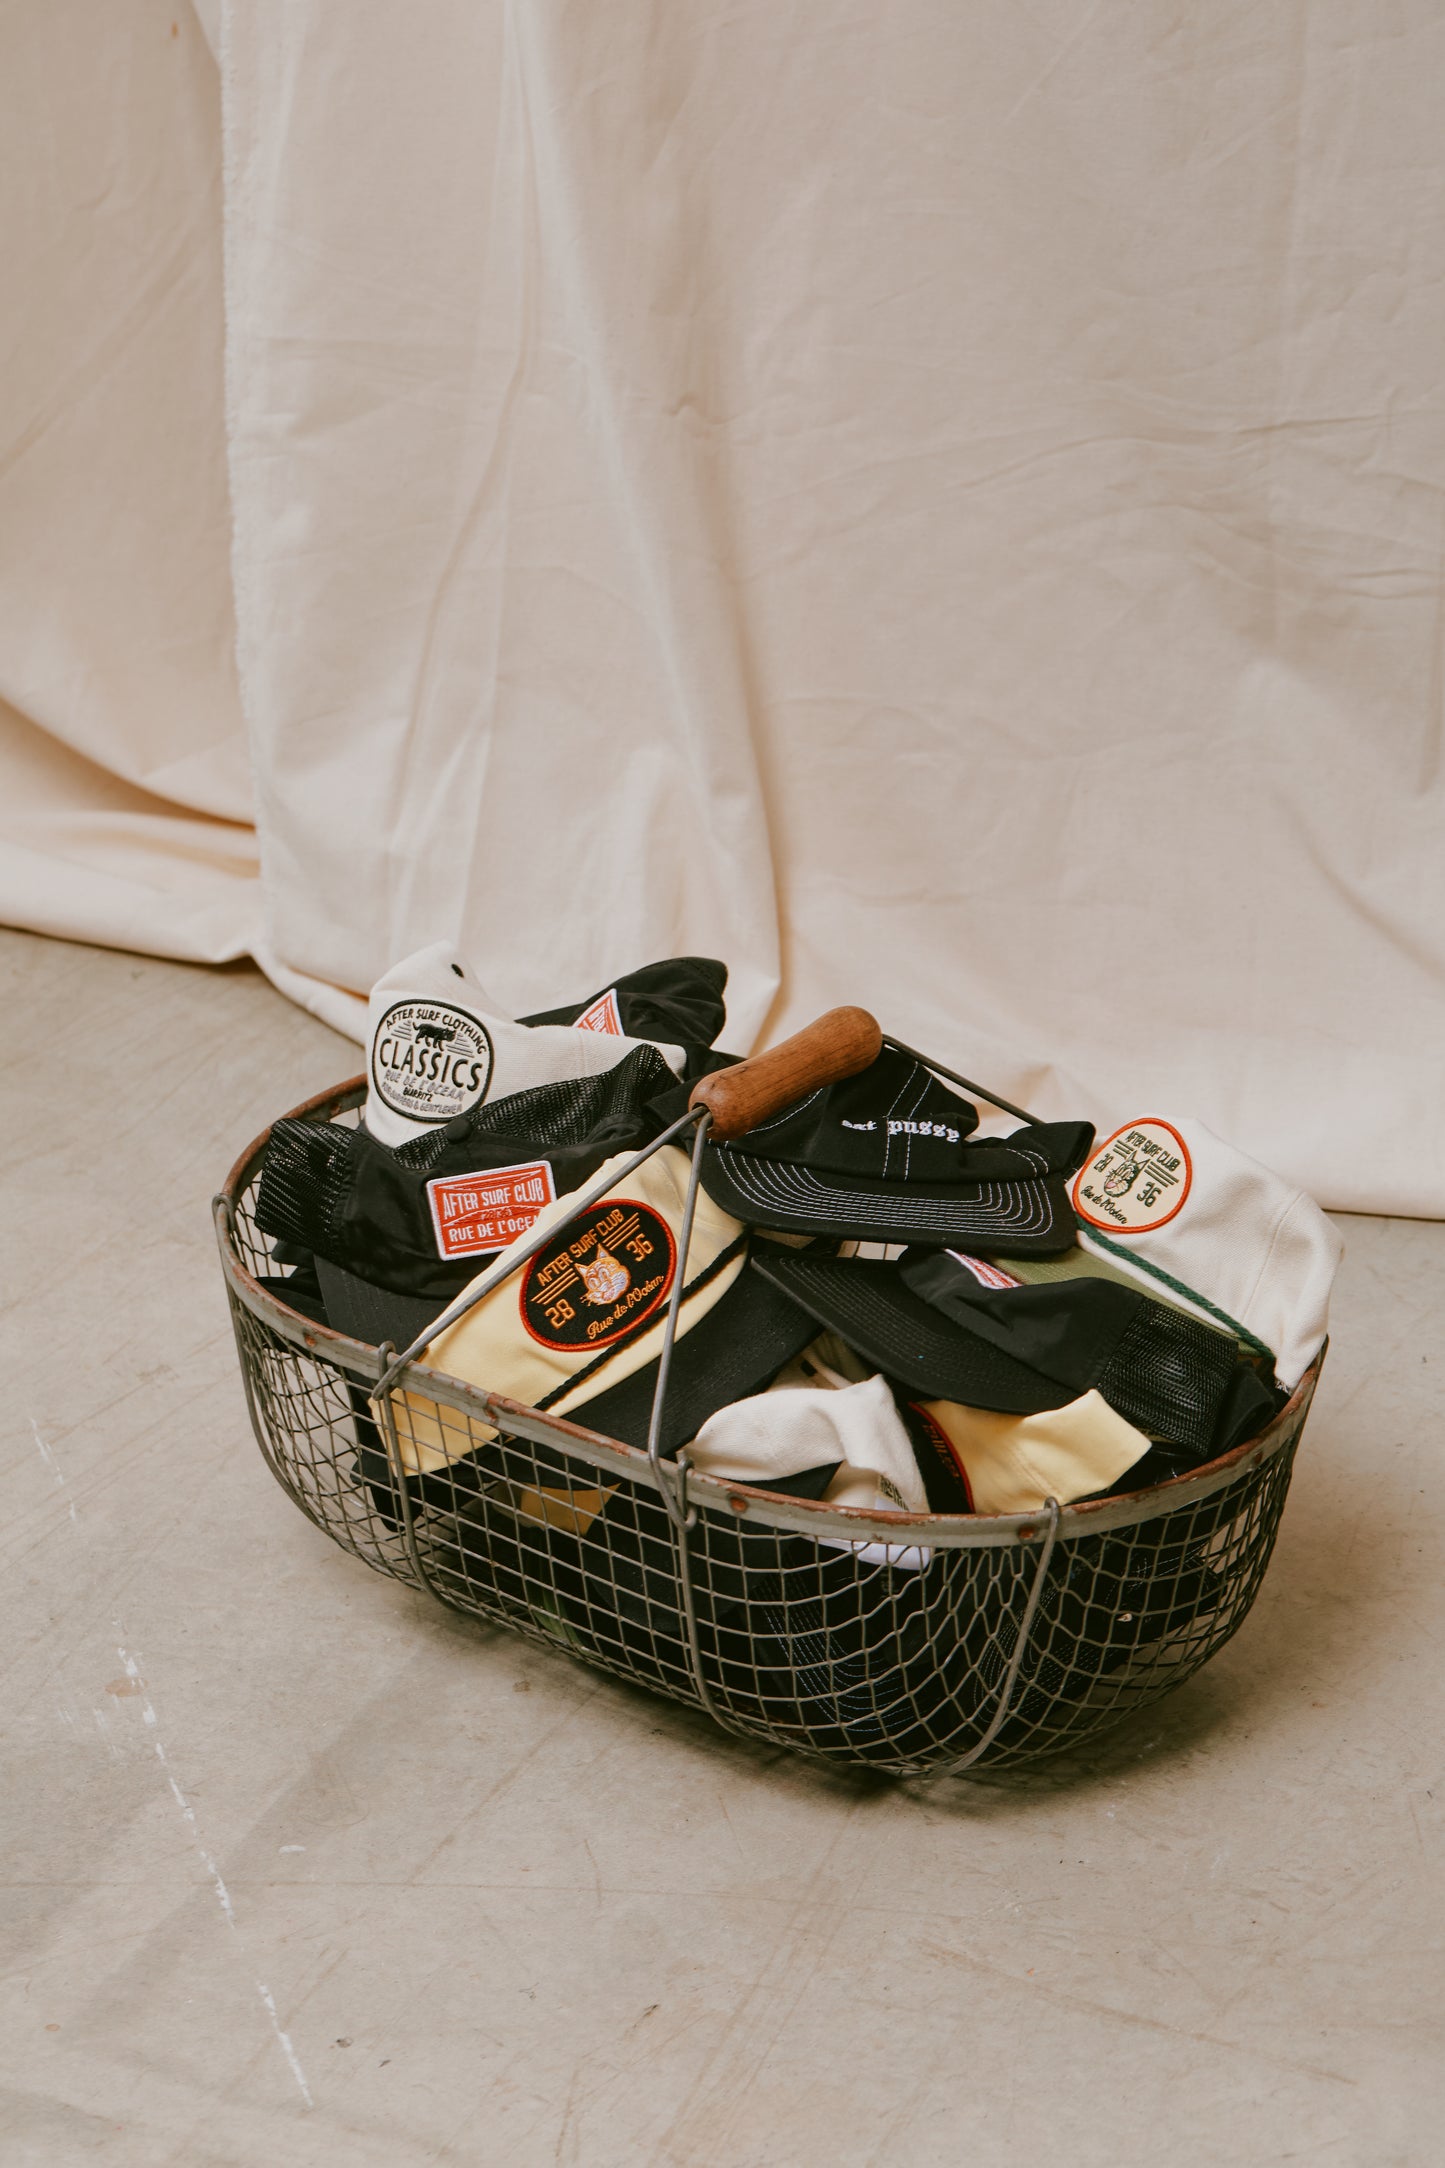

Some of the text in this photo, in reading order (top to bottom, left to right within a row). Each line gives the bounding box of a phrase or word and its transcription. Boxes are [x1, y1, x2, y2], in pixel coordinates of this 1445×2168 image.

[385, 1008, 487, 1055] AFTER SURF CLOTHING
[380, 1038, 483, 1092] CLASSICS
[1156, 1150, 1181, 1172] CLUB
[442, 1191, 479, 1220] AFTER
[481, 1186, 512, 1207] SURF
[513, 1177, 545, 1203] CLUB
[1136, 1181, 1162, 1207] 36
[448, 1225, 475, 1243] RUE
[476, 1222, 495, 1239] DE
[536, 1208, 625, 1287] AFTER SURF CLUB
[625, 1232, 655, 1262] 36
[544, 1298, 576, 1330] 28
[586, 1316, 615, 1341] Rue
[613, 1303, 629, 1320] de
